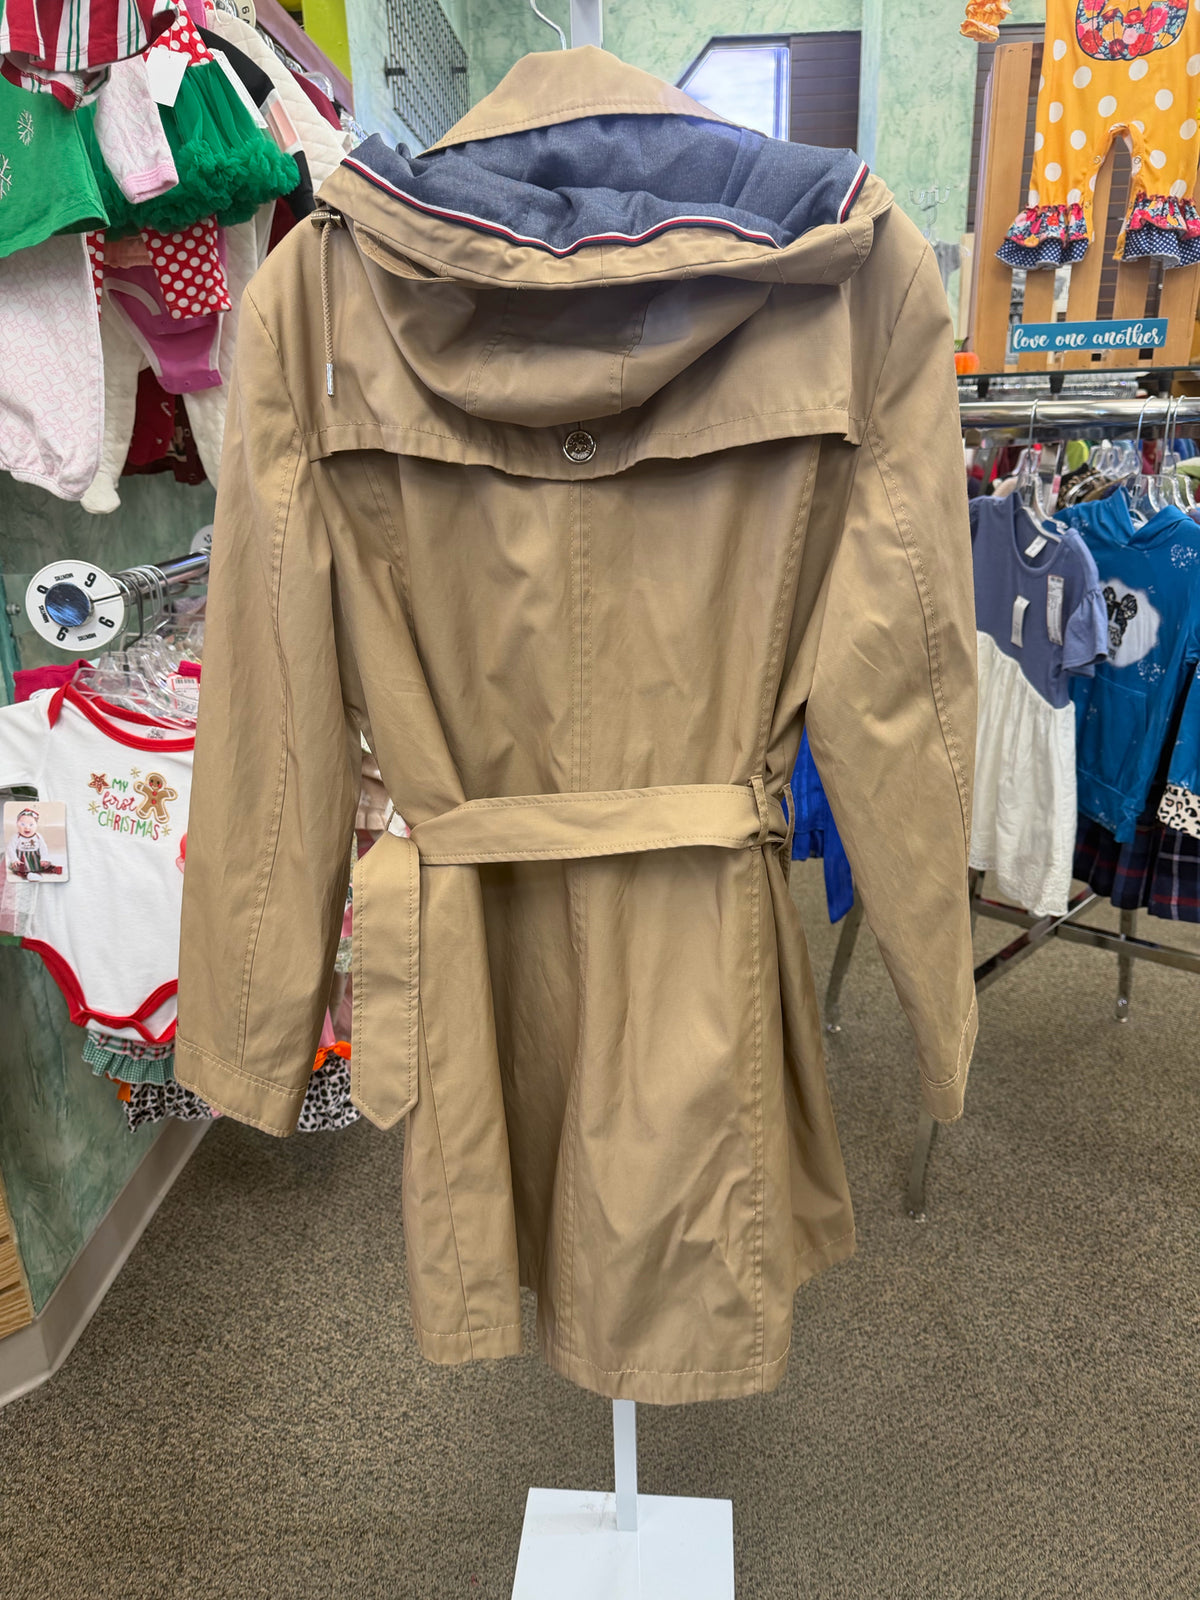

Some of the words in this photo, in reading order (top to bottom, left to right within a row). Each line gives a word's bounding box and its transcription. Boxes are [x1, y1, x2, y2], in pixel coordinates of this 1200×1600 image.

[1013, 328, 1050, 349] love
[1055, 333, 1087, 348] one
[1092, 323, 1163, 346] another
[111, 778, 129, 793] MY
[102, 790, 137, 811] first
[98, 810, 160, 840] CHRISTMAS
